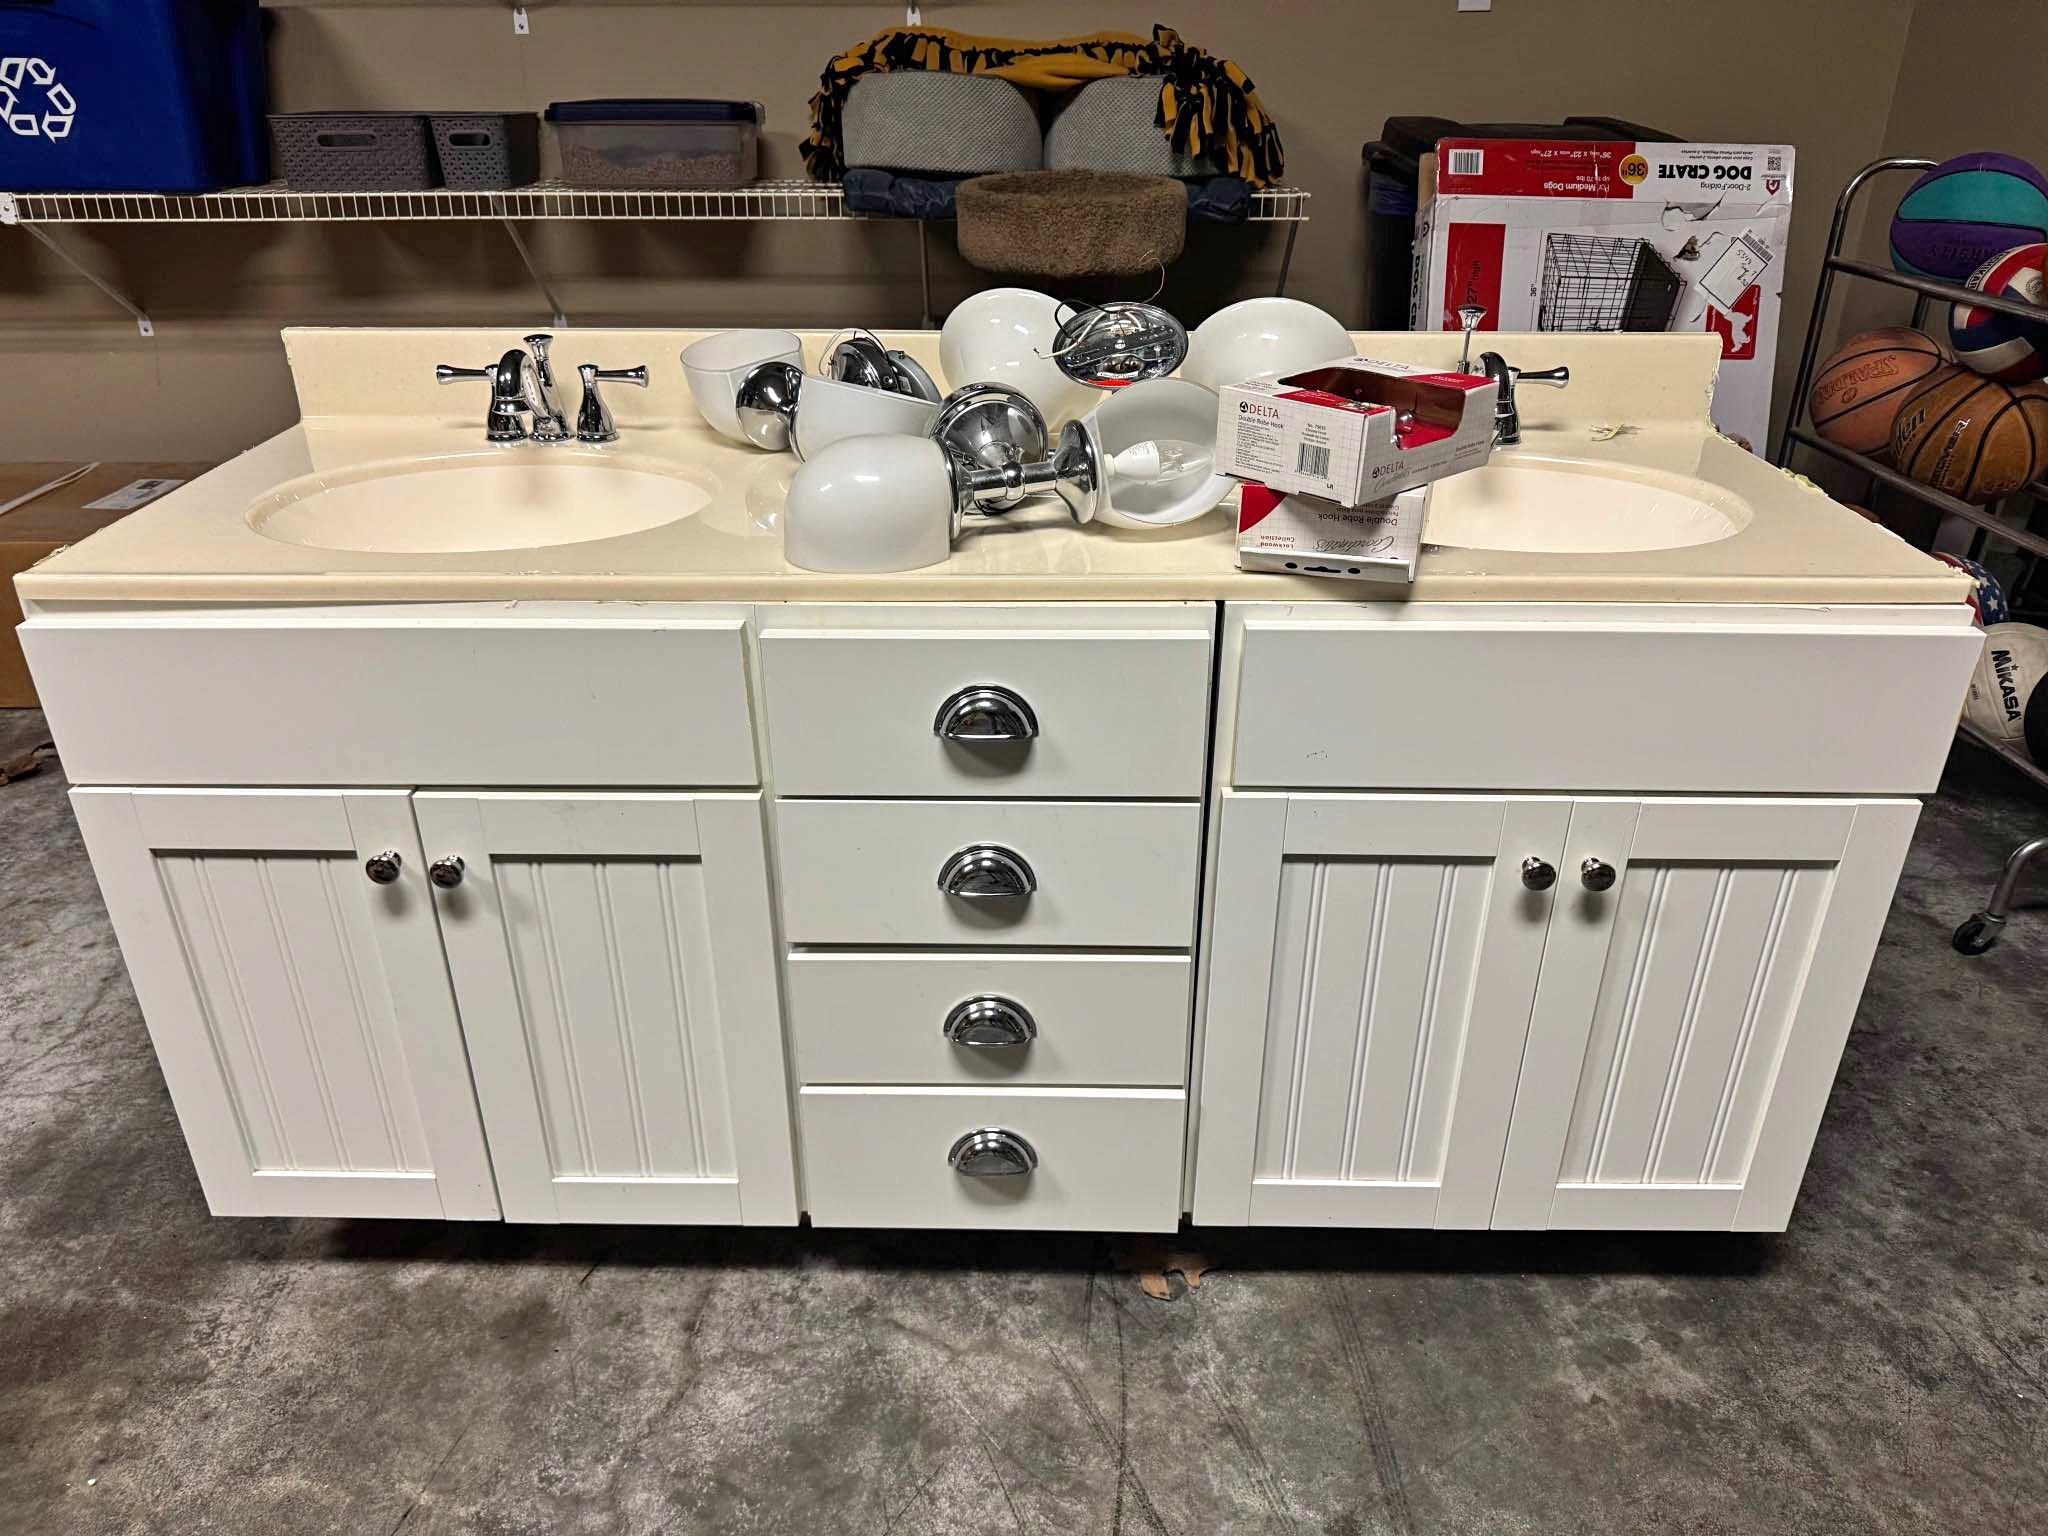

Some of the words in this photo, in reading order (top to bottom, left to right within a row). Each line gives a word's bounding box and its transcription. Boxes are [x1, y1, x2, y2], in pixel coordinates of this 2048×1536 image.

[1622, 162, 1646, 176] 36"
[1658, 164, 1710, 179] CRATE
[1713, 165, 1752, 180] DOG
[1543, 181, 1564, 190] Dogs
[1565, 183, 1596, 191] Medium
[1700, 182, 1726, 190] Folding
[1249, 404, 1280, 419] DELTA
[1238, 414, 1256, 424] Double
[1257, 418, 1270, 426] Robe
[1270, 421, 1284, 429] Hook
[1380, 461, 1405, 476] DELTA
[1317, 513, 1340, 523] Hook
[1342, 514, 1364, 524] Robe
[1366, 516, 1398, 526] Double
